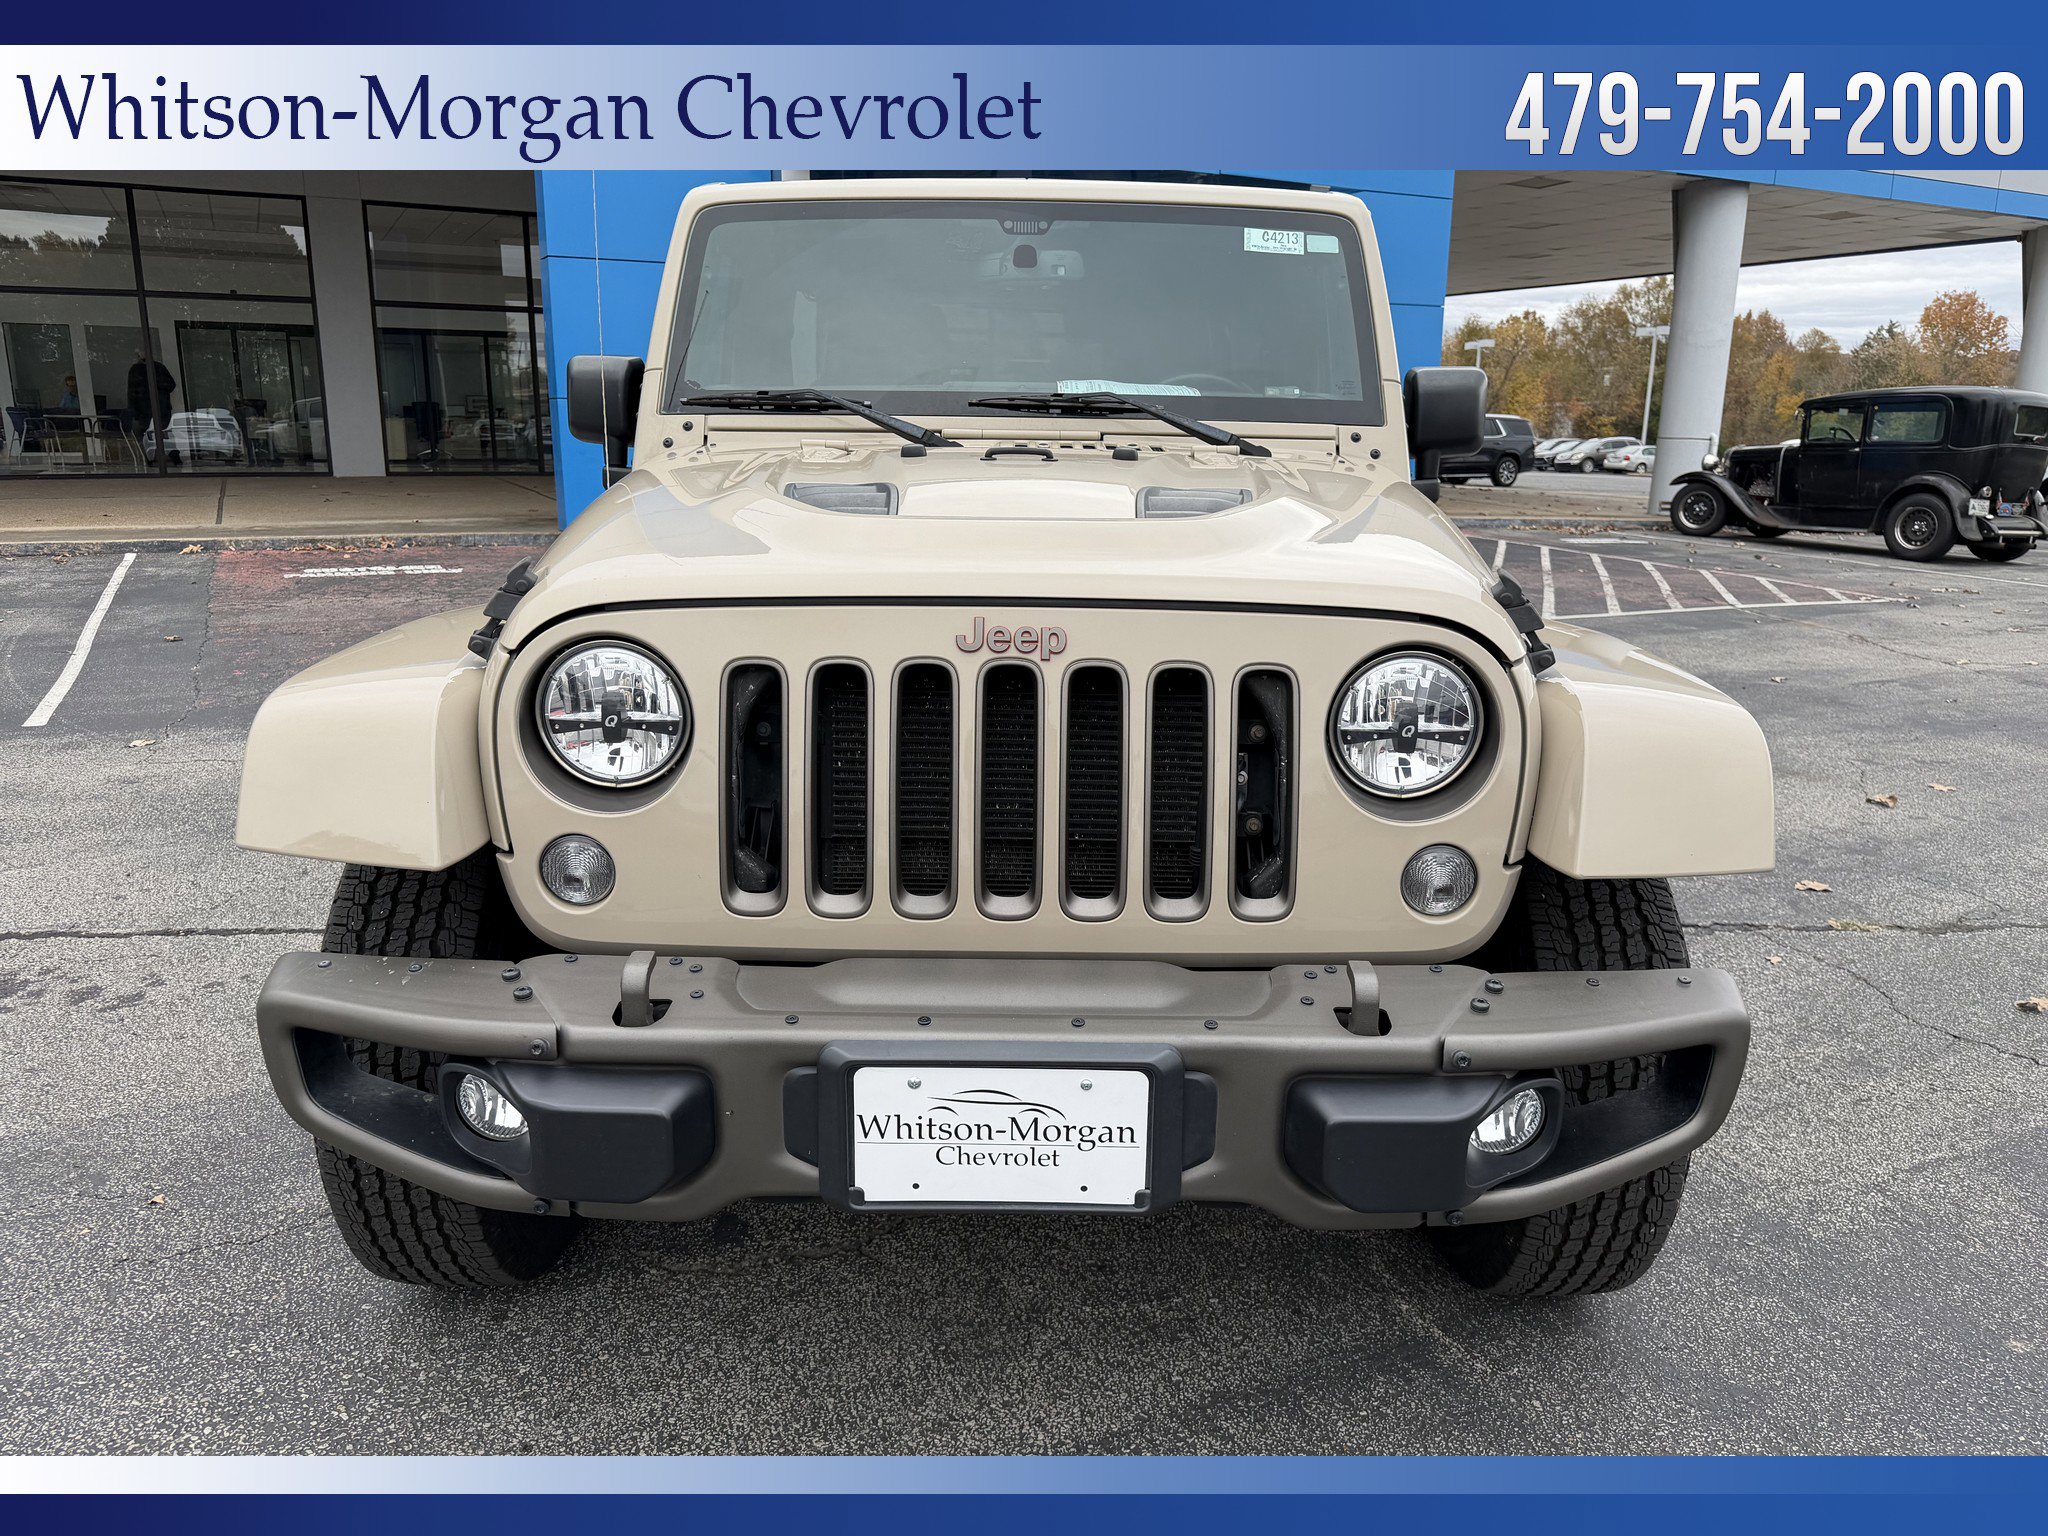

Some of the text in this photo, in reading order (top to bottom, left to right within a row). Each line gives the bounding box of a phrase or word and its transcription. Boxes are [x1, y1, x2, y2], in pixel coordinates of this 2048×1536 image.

[1262, 230, 1299, 245] C4213
[955, 616, 1068, 662] Jeep
[856, 1113, 1137, 1152] Whitson-Morgan
[935, 1145, 1060, 1168] Chevrolet
